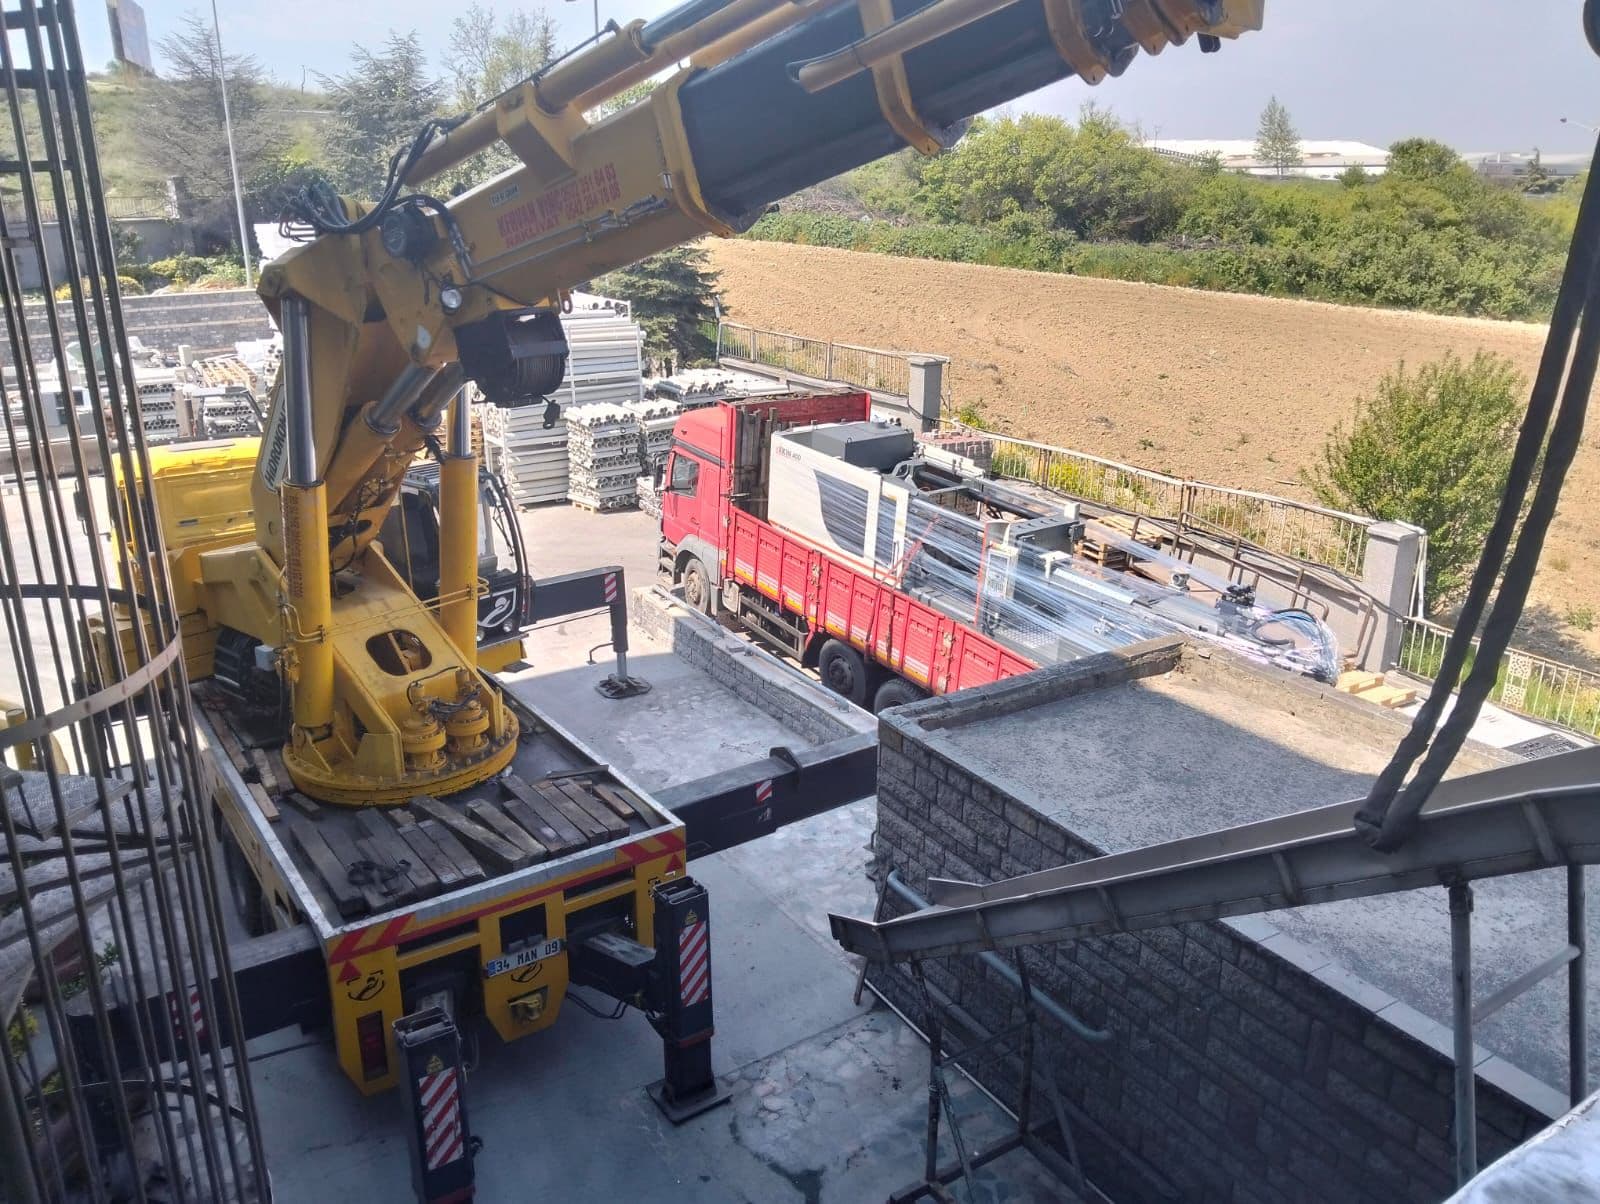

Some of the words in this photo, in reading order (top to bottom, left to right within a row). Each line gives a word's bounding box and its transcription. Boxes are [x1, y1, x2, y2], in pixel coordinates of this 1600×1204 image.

[496, 960, 510, 973] 34
[517, 948, 538, 965] MAN
[545, 941, 558, 955] 09
